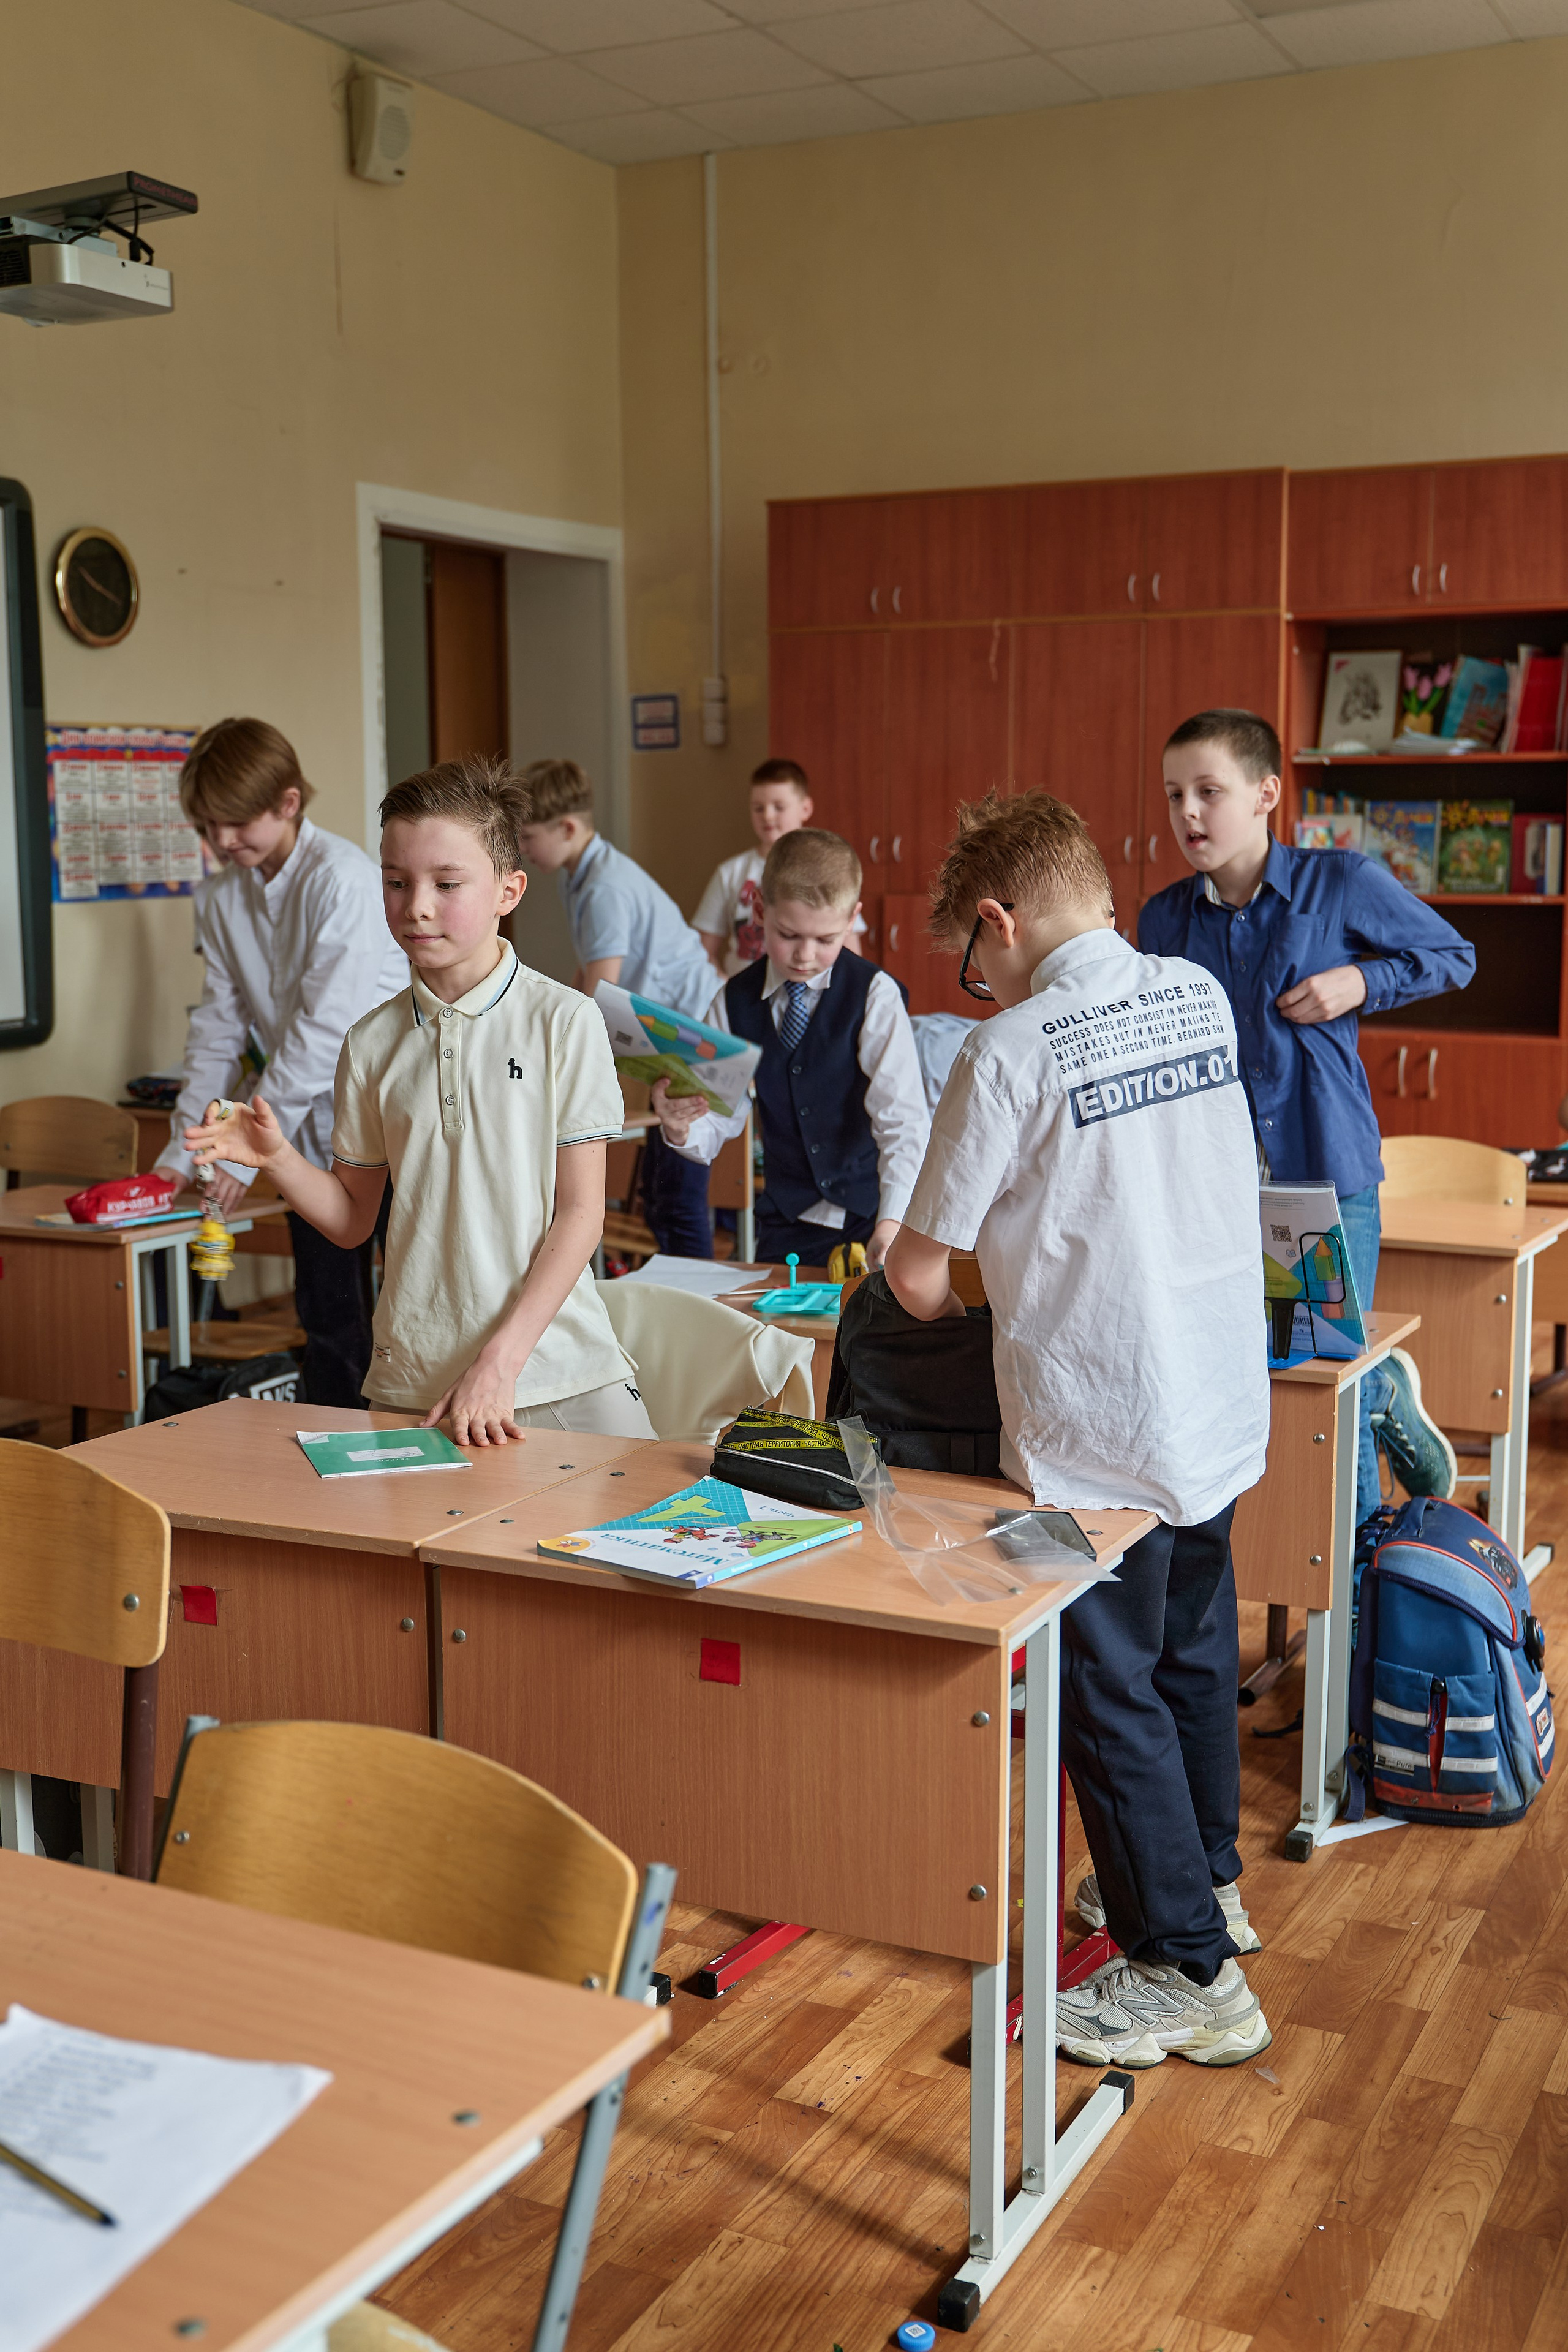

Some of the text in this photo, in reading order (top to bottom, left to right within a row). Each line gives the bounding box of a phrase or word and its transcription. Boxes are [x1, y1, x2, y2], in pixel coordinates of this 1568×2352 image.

[1042, 982, 1212, 1035] GULLIVER SINCE 1997
[1050, 1027, 1091, 1050] SUCCESS
[1093, 1020, 1114, 1033] DOES
[1116, 1017, 1131, 1028] NOT
[1133, 1009, 1164, 1024] CONSIST
[1166, 1007, 1175, 1017] IN
[1177, 1003, 1197, 1015] NEVER
[1055, 1012, 1221, 1062] MISTAKES BUT IN NEVER MAKING TE
[1060, 1024, 1224, 1074] SAME ONE A SECOND TIME. BERNARD SH
[1076, 1044, 1239, 1121] EDITION.01
[229, 1371, 300, 1403] ANS
[738, 1441, 764, 1450] ЧАСТНАЯ
[790, 1419, 818, 1436] ТЕРРИТОРИЯ
[821, 1433, 843, 1448] ЧАСТНАЯ
[769, 1508, 794, 1518] Часть
[600, 1533, 730, 1566] Математика
